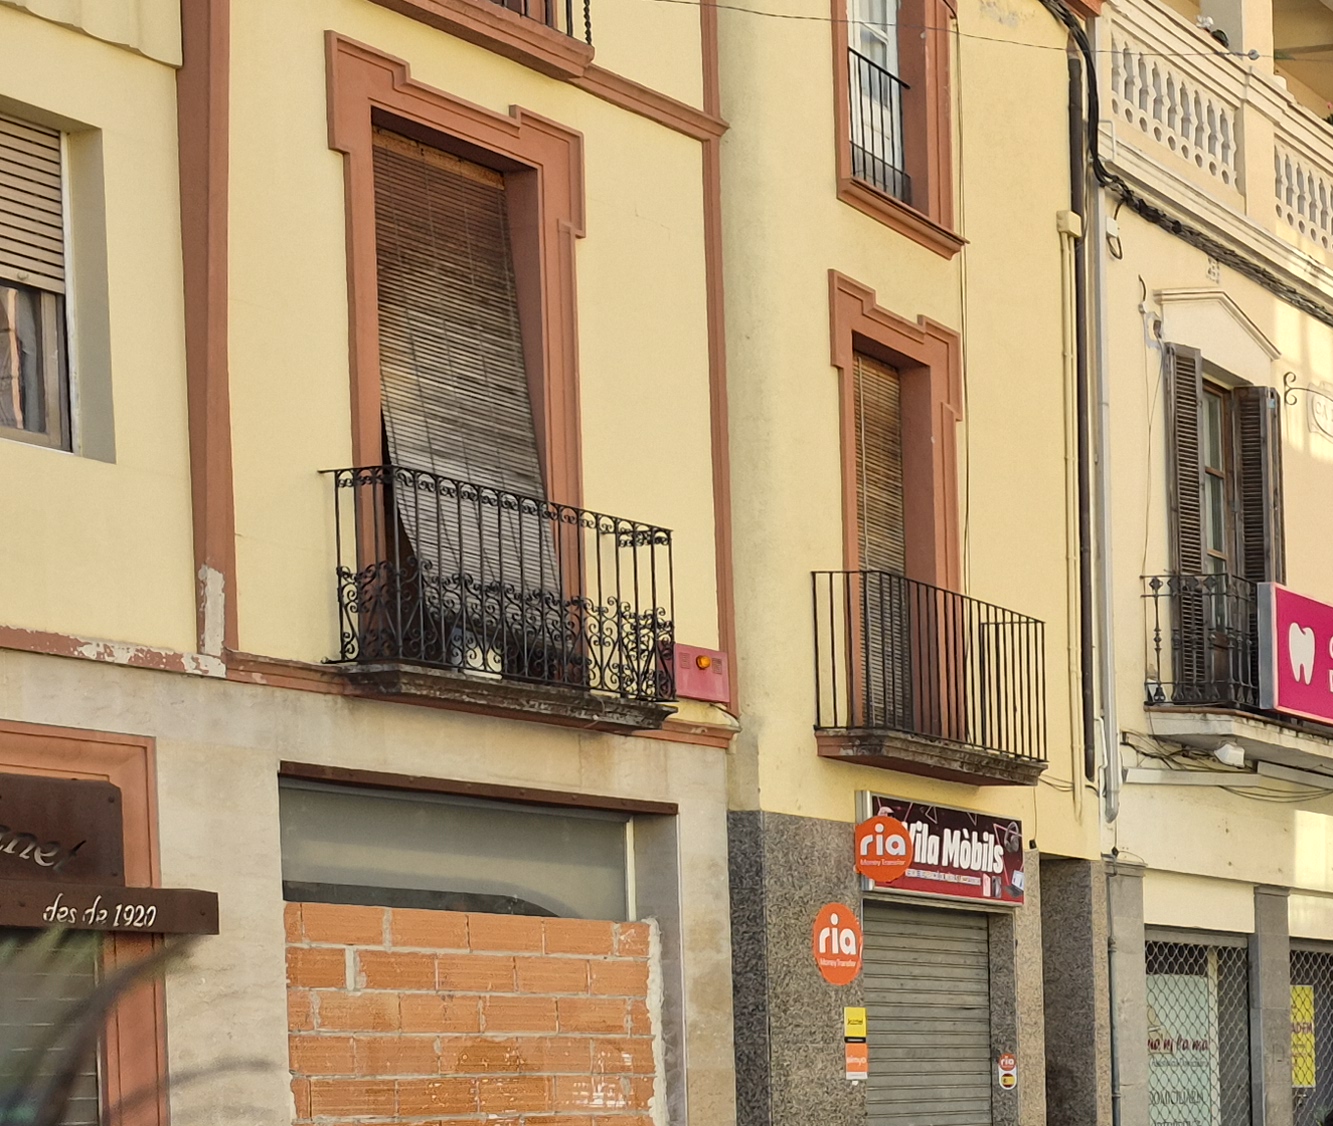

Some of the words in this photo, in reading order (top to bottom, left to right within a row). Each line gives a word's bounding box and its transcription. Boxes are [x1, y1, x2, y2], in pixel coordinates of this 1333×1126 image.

[0, 825, 87, 873] net
[860, 823, 906, 856] ria
[941, 827, 1004, 874] Mòbils
[43, 893, 77, 923] des
[83, 895, 108, 925] de
[113, 904, 157, 927] 1920
[819, 913, 856, 955] ria
[1000, 1055, 1015, 1066] ria
